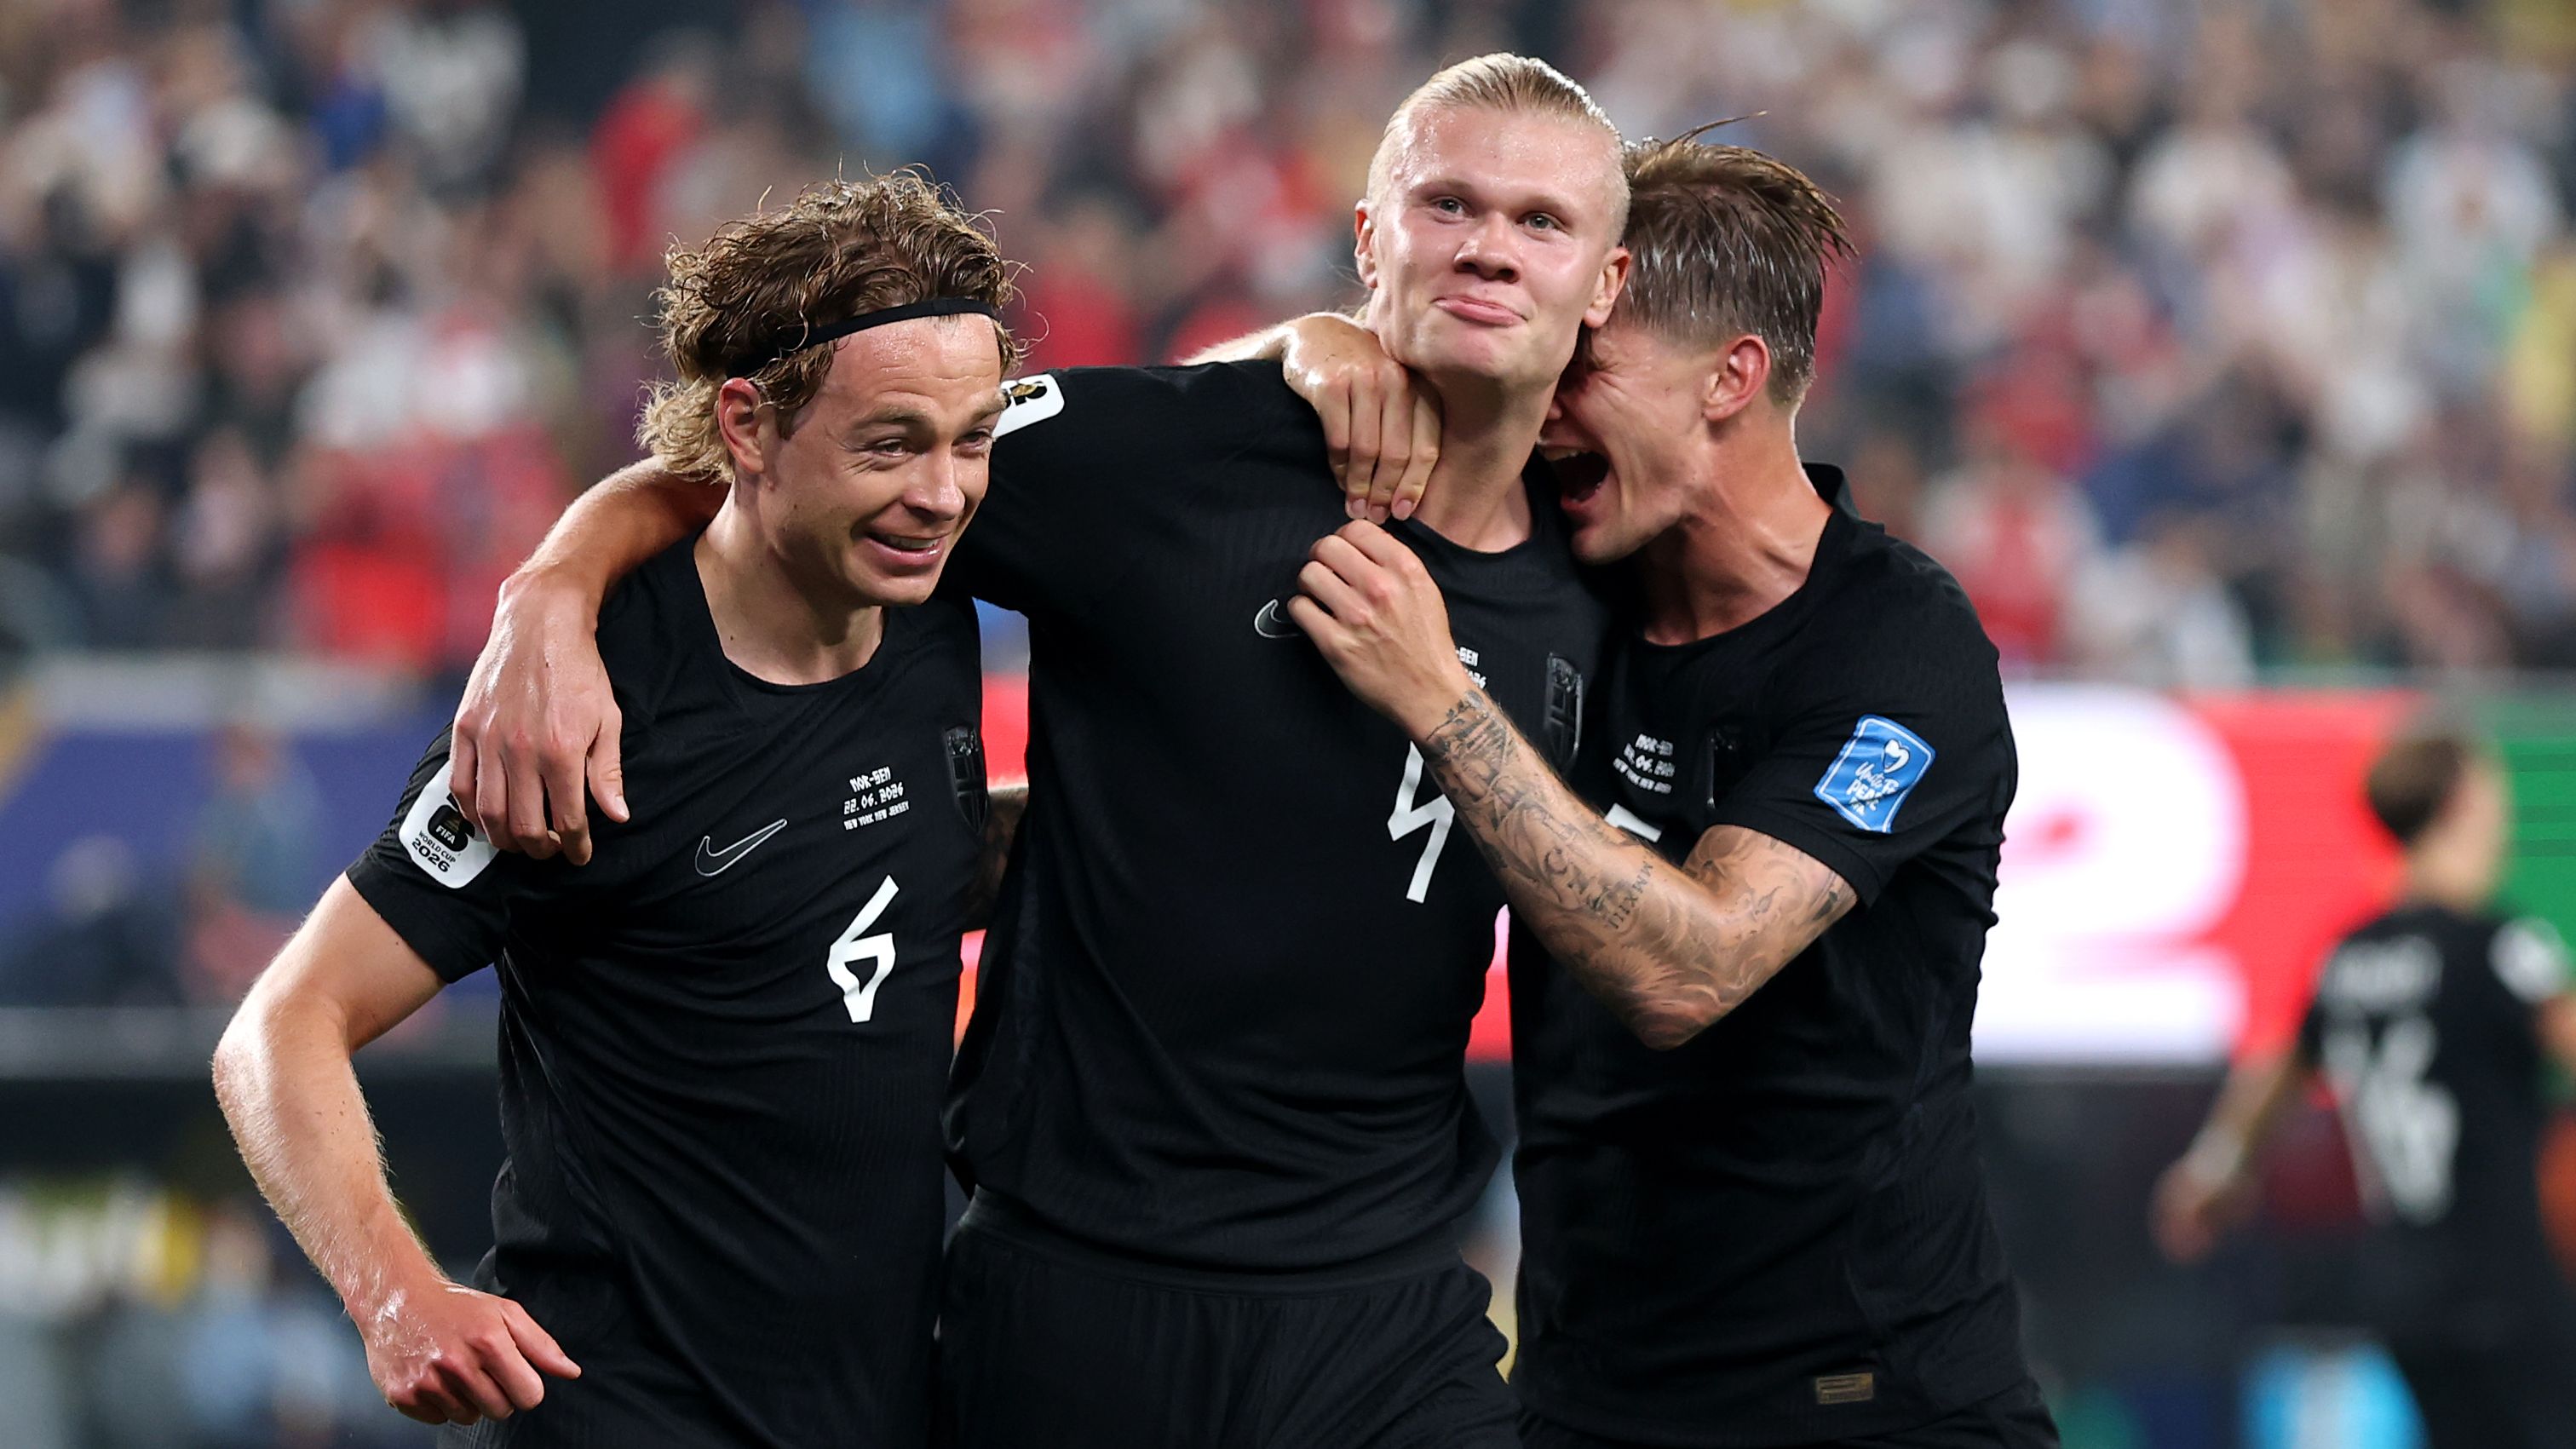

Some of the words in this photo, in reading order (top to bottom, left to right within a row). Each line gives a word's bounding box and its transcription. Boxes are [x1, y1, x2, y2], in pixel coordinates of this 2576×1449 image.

[1455, 647, 1479, 667] -SEN
[849, 766, 891, 793] NOR-SEN
[843, 819, 858, 831] NEW
[857, 814, 875, 826] YORK
[874, 808, 888, 822] NEW
[888, 801, 910, 817] JERSEY
[418, 830, 442, 853] WORLD
[440, 849, 457, 864] CUP
[435, 825, 457, 845] FIFA
[411, 837, 451, 873] 2026
[826, 873, 900, 1024] 6
